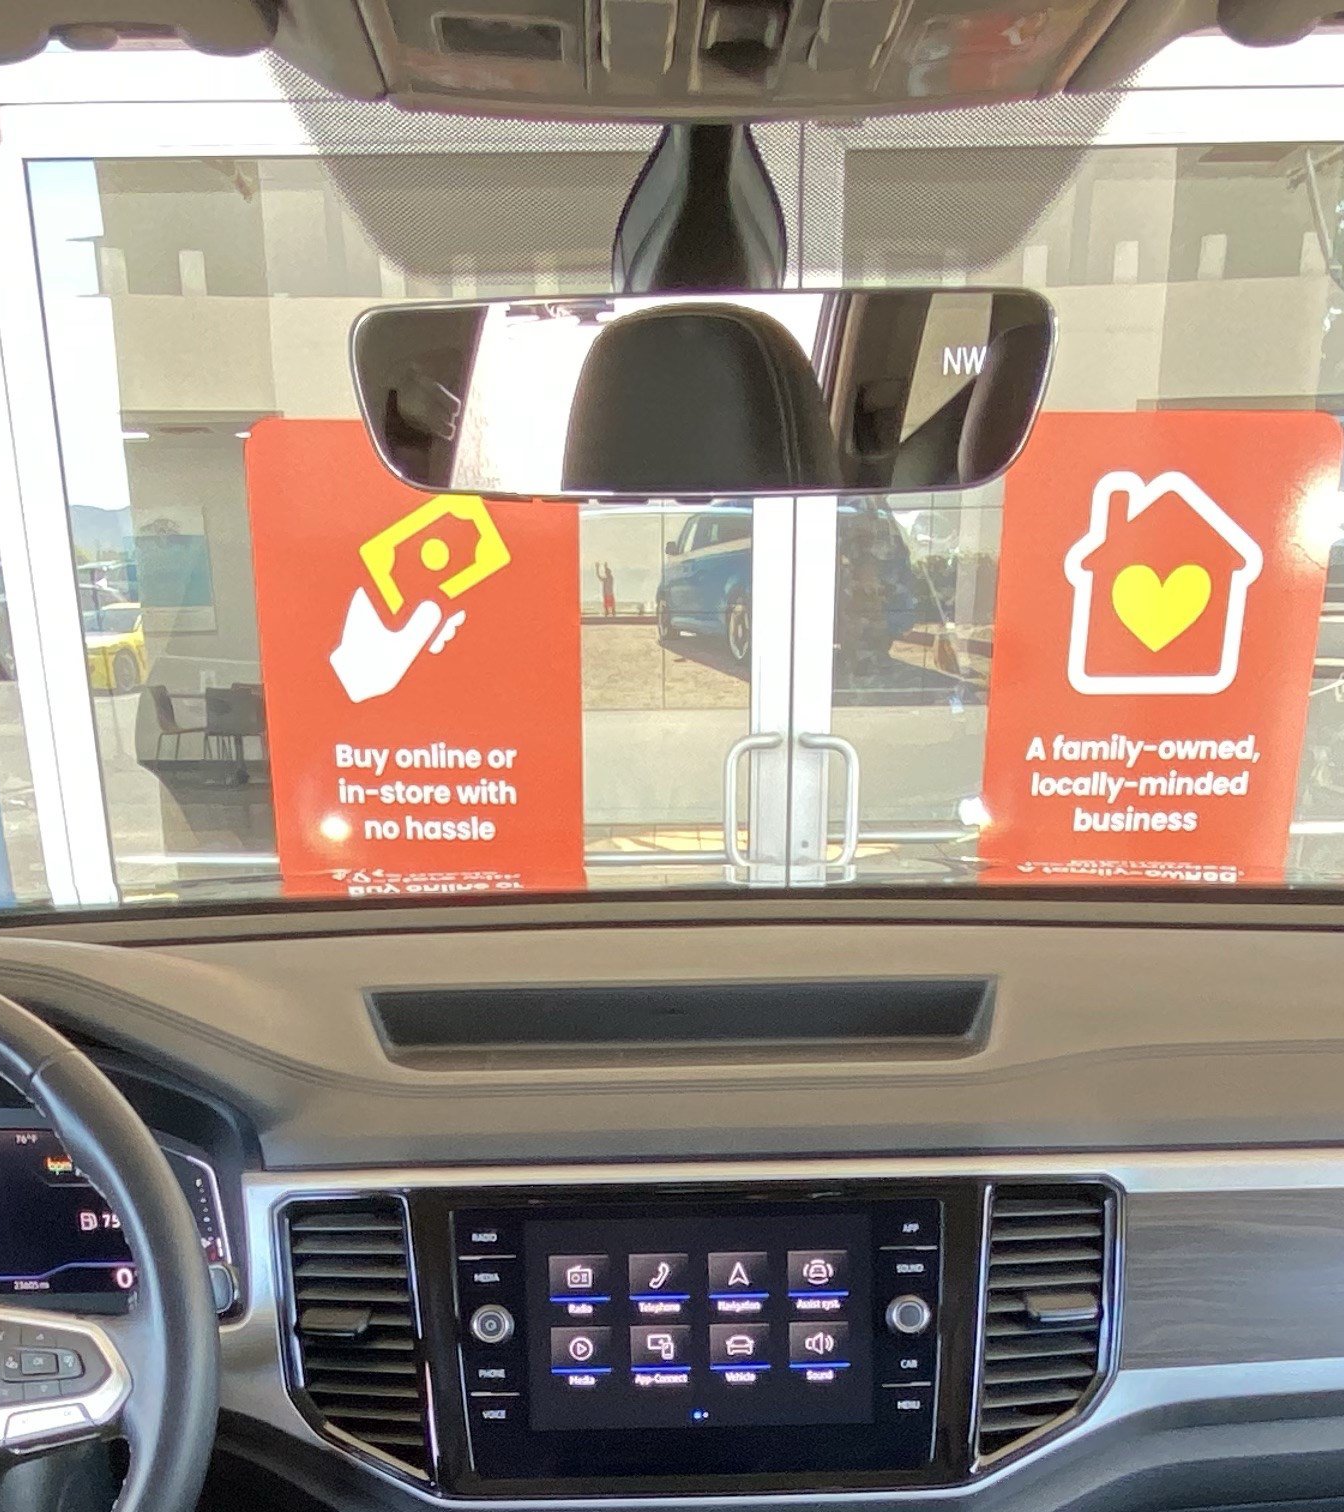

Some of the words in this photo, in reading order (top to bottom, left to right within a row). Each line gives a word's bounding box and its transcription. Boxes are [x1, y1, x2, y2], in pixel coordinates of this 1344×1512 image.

[942, 345, 987, 376] NW
[335, 743, 390, 776] Buy
[394, 741, 482, 769] online
[487, 748, 518, 769] or
[1025, 736, 1047, 761] A
[1052, 733, 1261, 768] family-owned,
[338, 776, 451, 805] in-store
[455, 776, 517, 805] with
[1031, 768, 1250, 804] locally-minded
[364, 819, 401, 840] no
[405, 815, 496, 841] hassle
[1073, 804, 1198, 833] business
